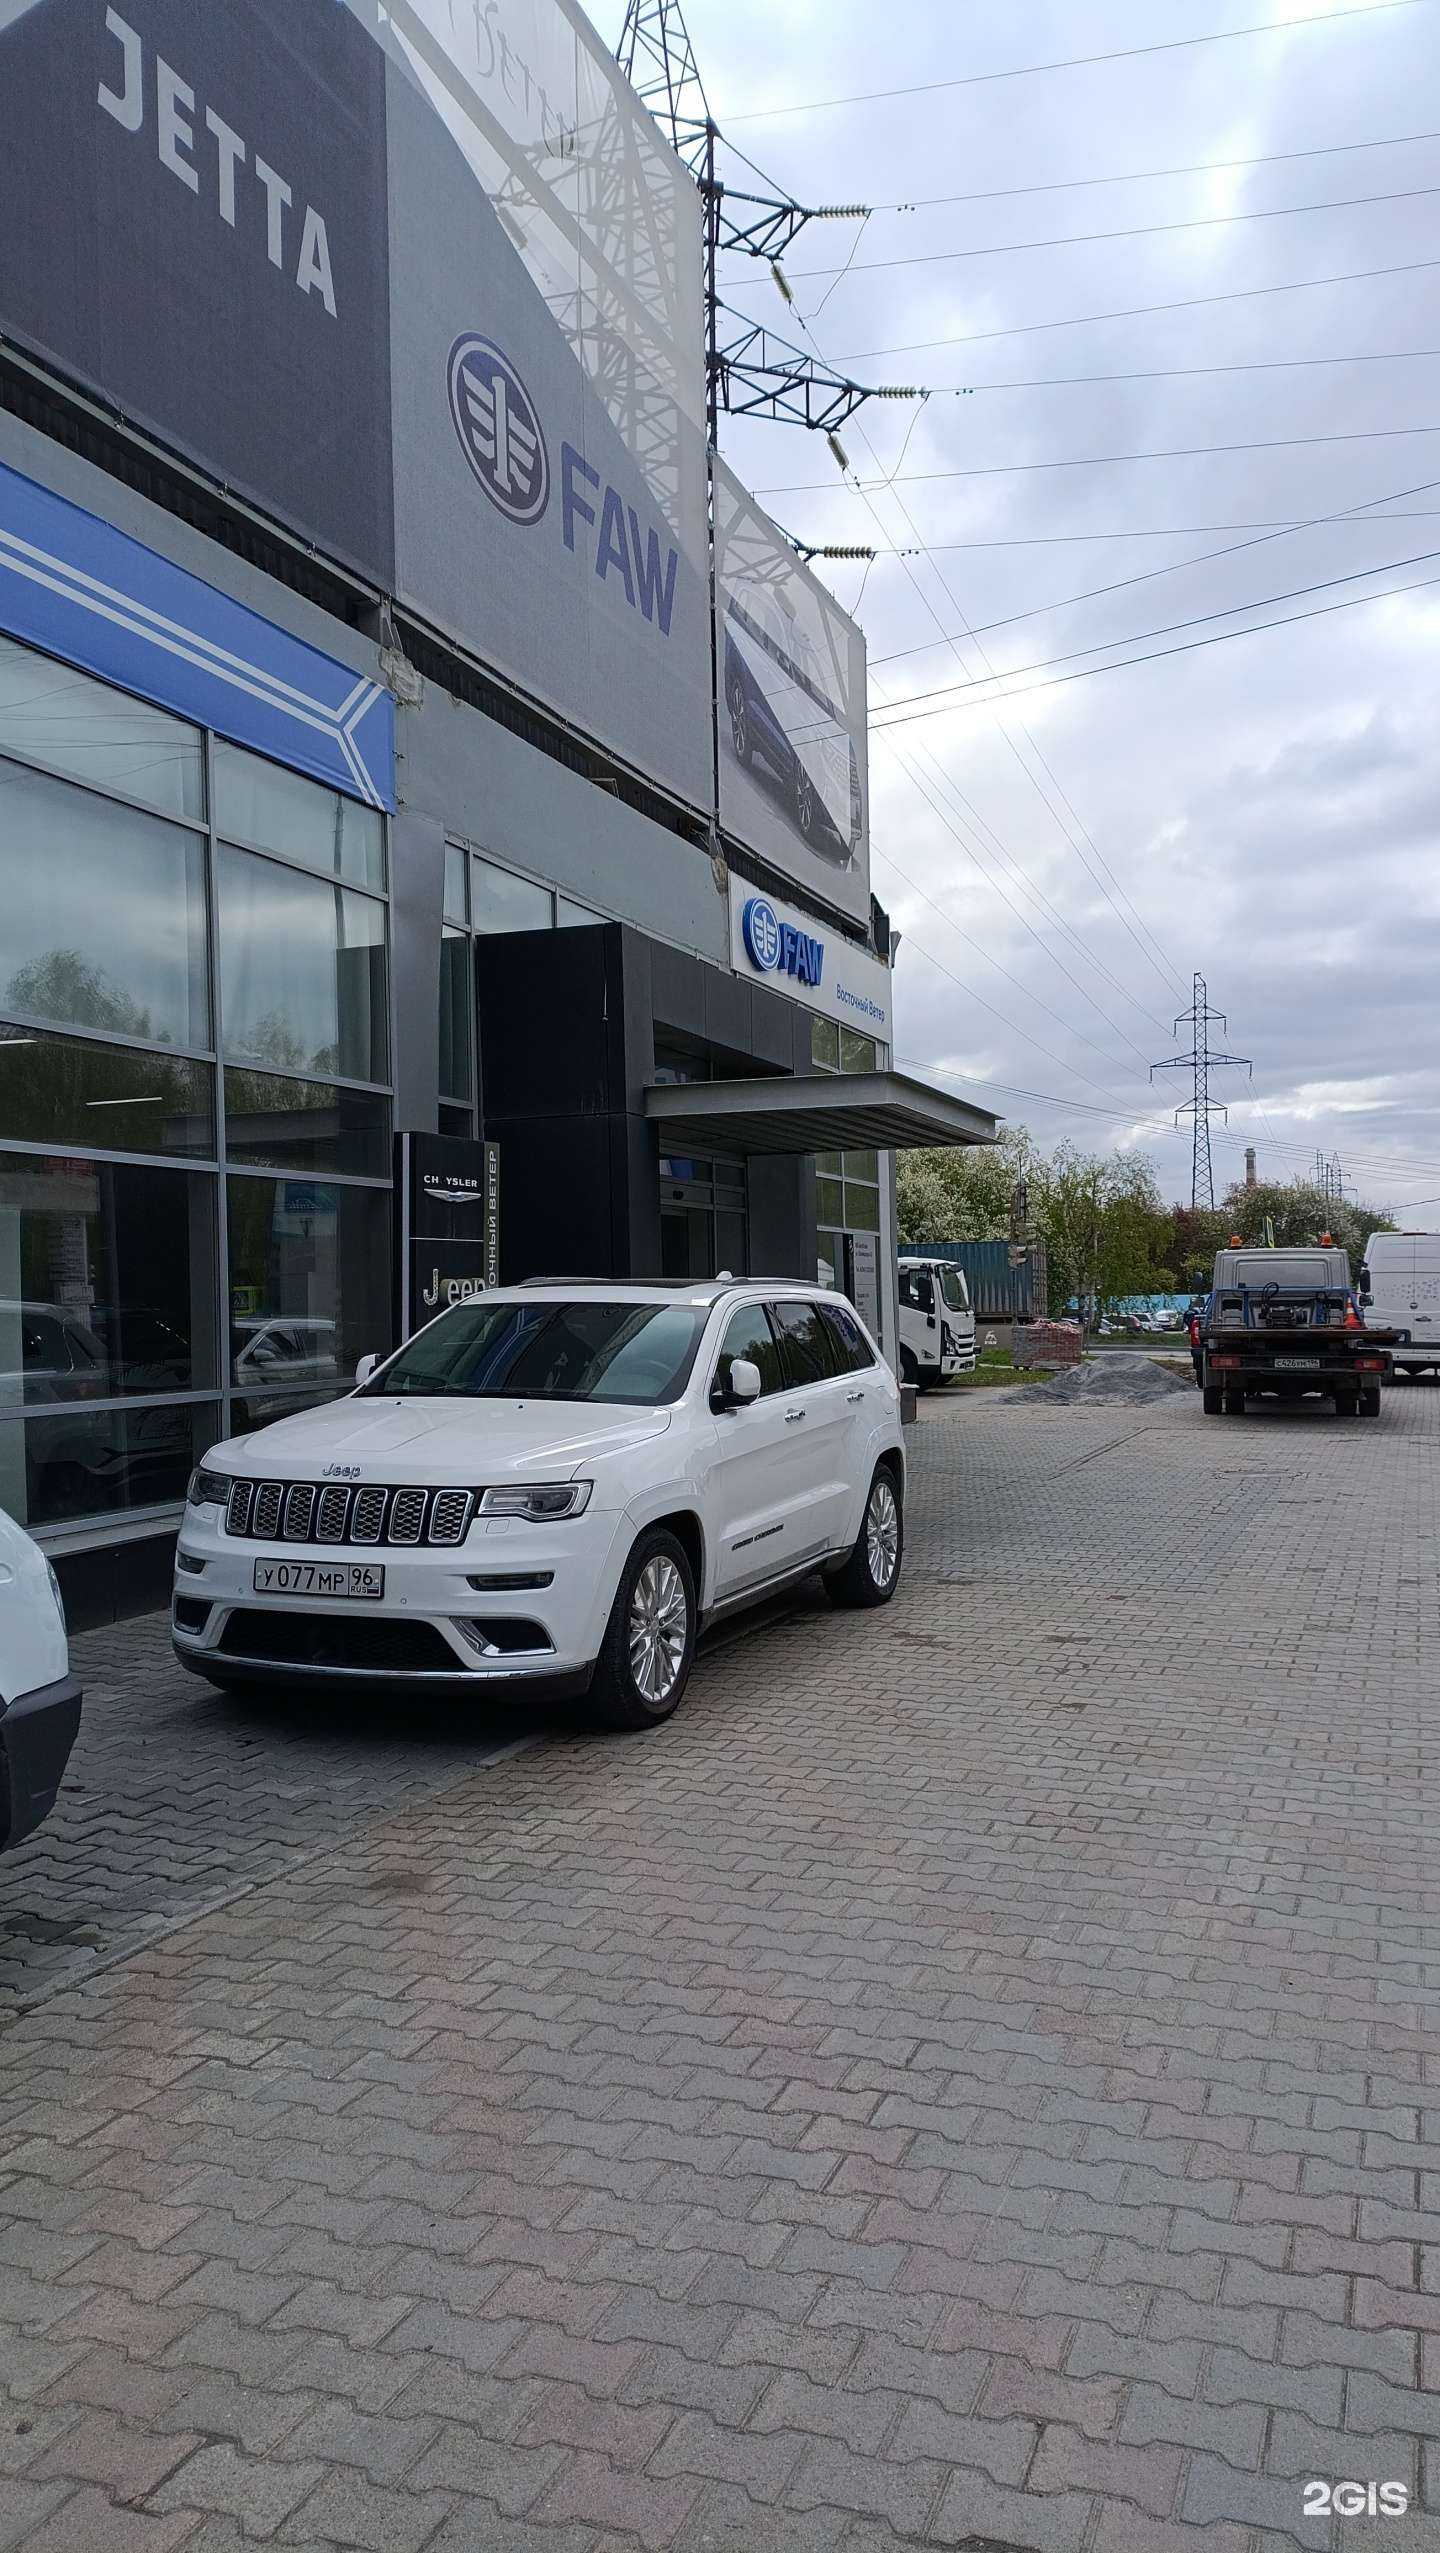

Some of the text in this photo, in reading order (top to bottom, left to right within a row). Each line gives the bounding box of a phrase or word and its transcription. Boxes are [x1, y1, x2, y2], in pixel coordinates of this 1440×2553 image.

[97, 5, 338, 318] JETTA
[561, 440, 679, 637] FAW
[778, 923, 824, 986] FAW
[836, 983, 886, 1024] Восточный Ветер
[423, 1174, 478, 1188] CHYSLER
[488, 1149, 498, 1288] ОЧНЫЙ ВЕТЕР
[322, 1462, 362, 1480] Jeep
[350, 1585, 367, 1594] RUS
[351, 1567, 373, 1586] 96
